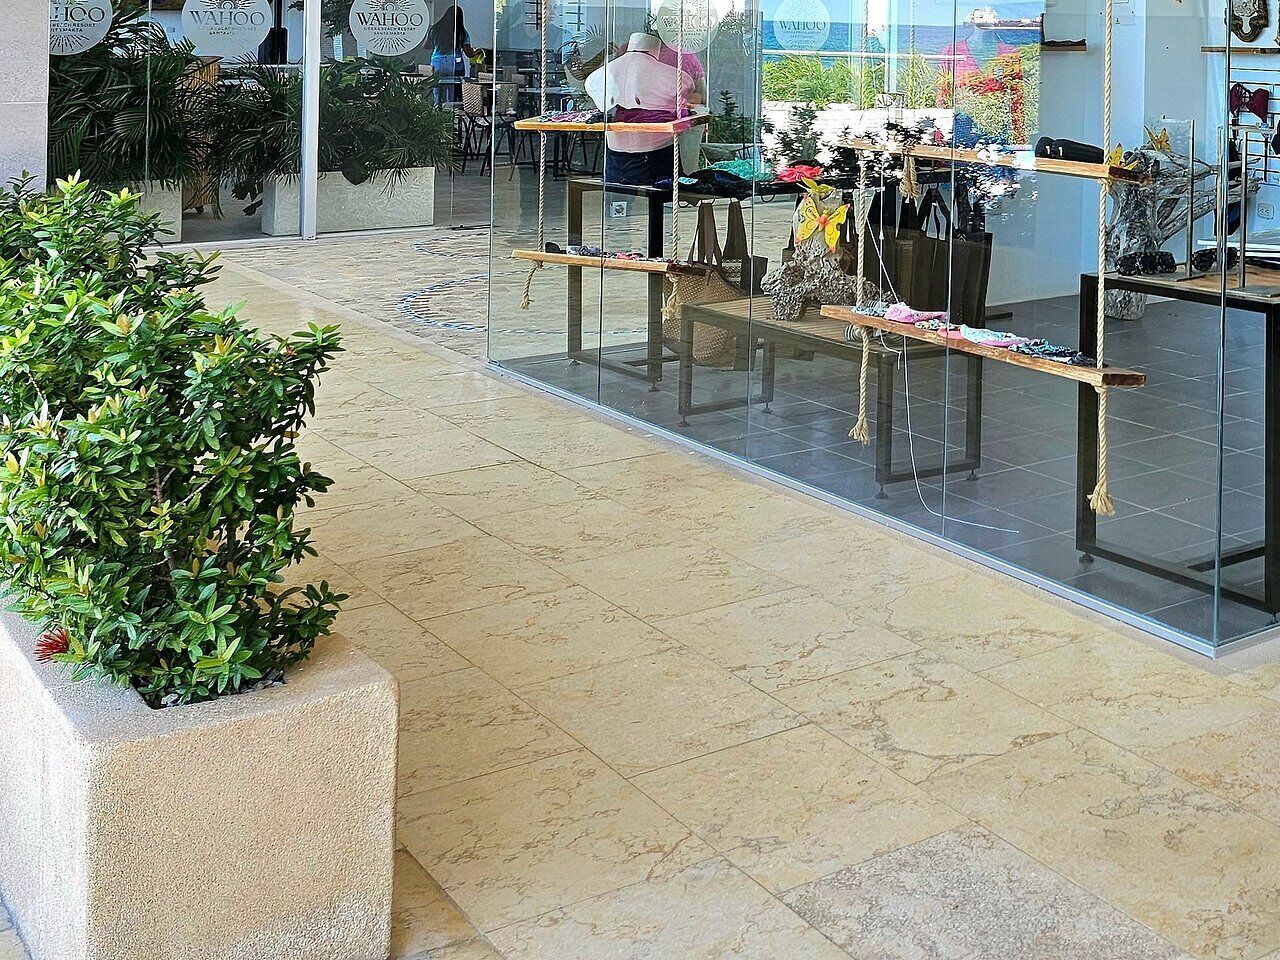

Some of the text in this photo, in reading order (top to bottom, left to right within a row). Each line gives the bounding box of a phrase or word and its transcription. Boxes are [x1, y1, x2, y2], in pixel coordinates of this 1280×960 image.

[189, 10, 265, 26] WAHOO
[356, 12, 423, 27] WAHOO
[780, 20, 826, 31] WAHOO
